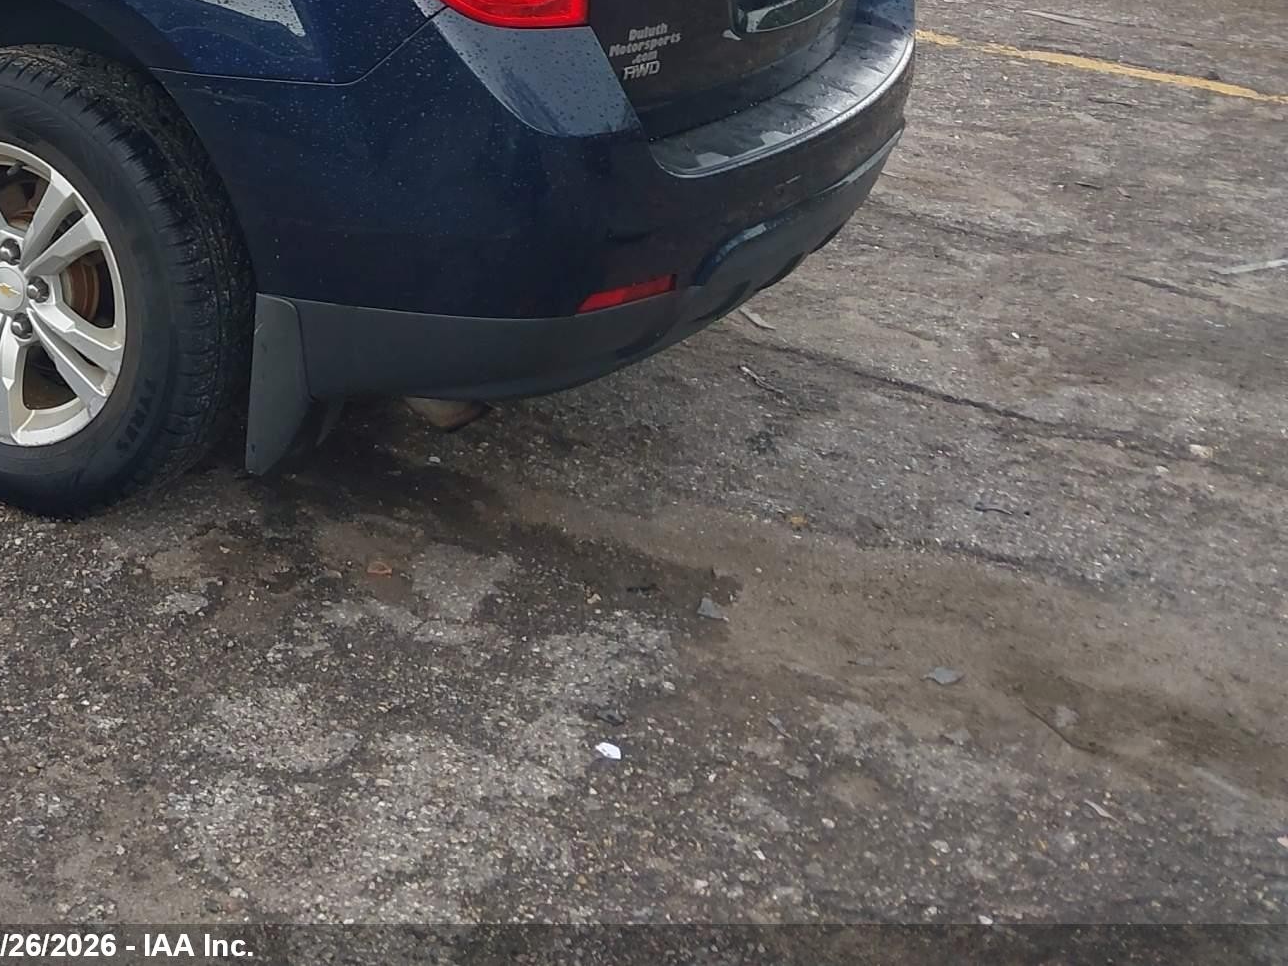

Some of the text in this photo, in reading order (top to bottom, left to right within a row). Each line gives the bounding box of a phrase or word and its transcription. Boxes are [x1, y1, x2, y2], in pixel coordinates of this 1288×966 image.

[628, 23, 668, 41] Duluth
[609, 32, 682, 57] Motorsports
[632, 50, 658, 64] .com
